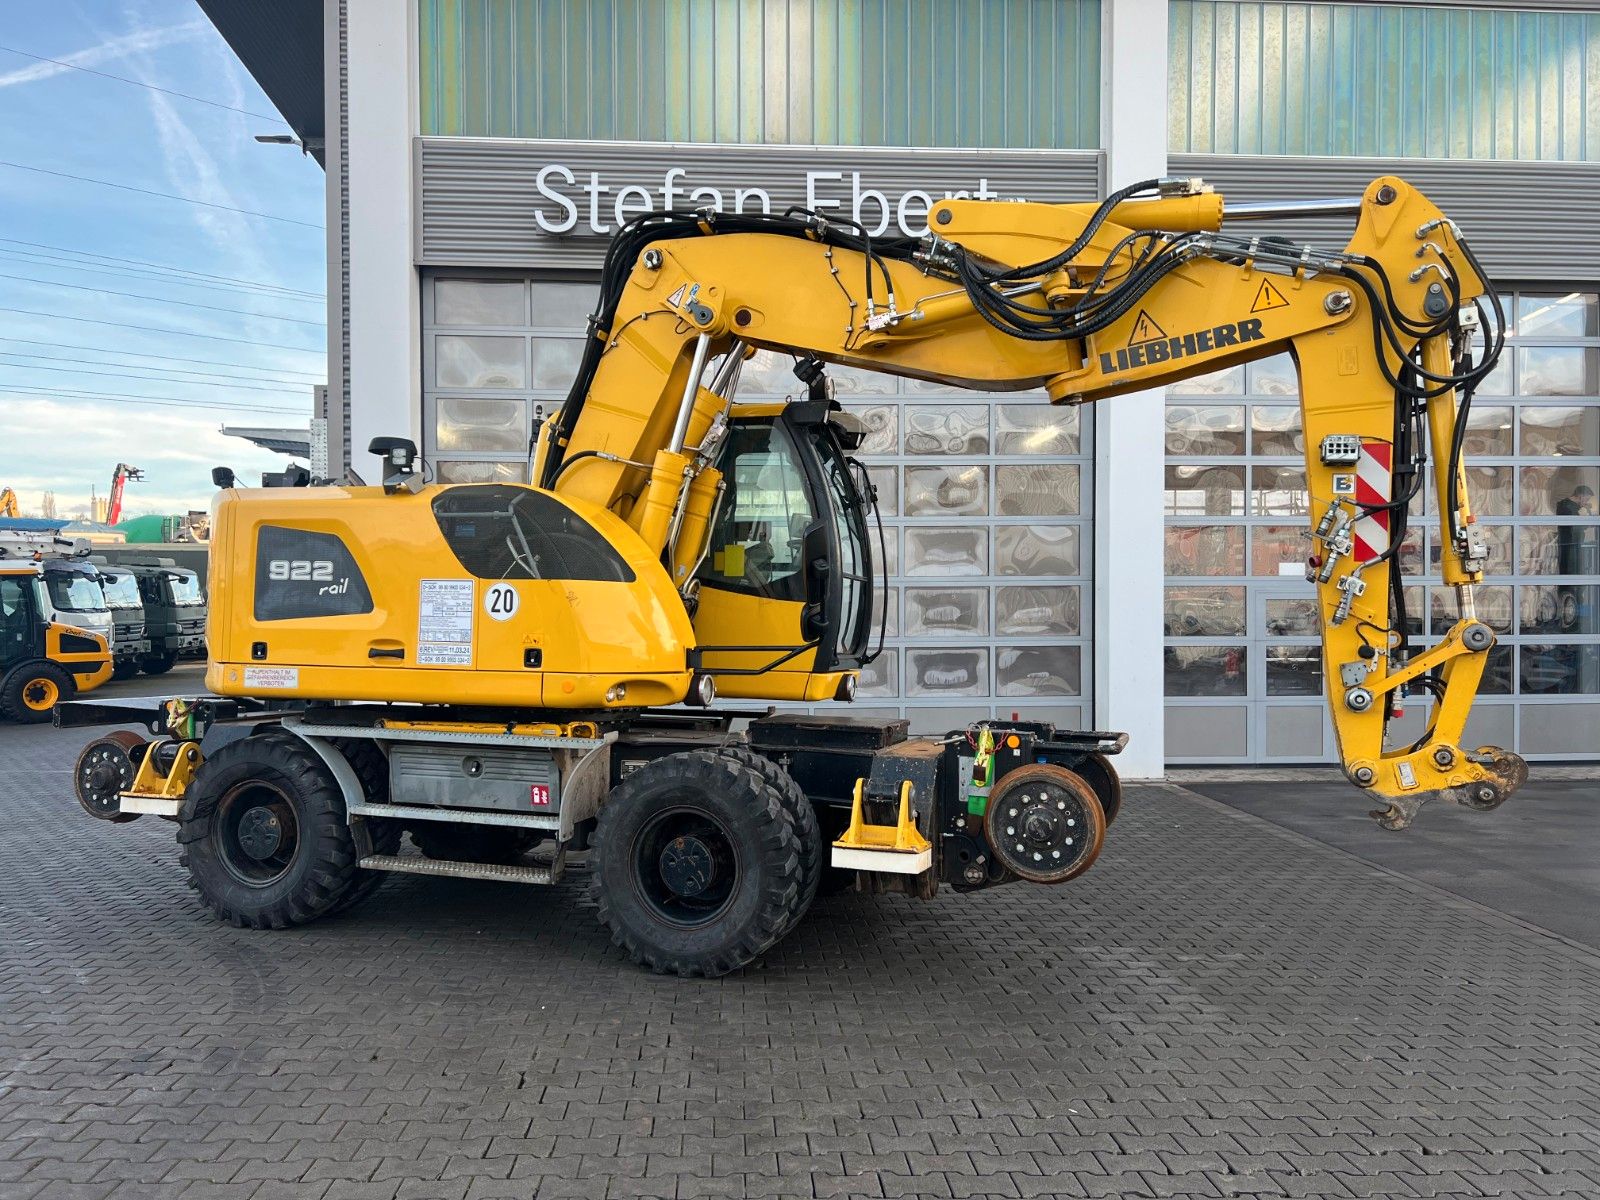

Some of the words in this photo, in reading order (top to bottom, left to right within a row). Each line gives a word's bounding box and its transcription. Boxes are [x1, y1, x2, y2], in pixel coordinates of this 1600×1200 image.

[534, 164, 771, 234] Stefan
[805, 171, 998, 238] Ebe
[1099, 318, 1266, 375] LIEBHERR
[269, 560, 334, 581] 922
[319, 578, 349, 595] rail
[491, 589, 513, 613] 20
